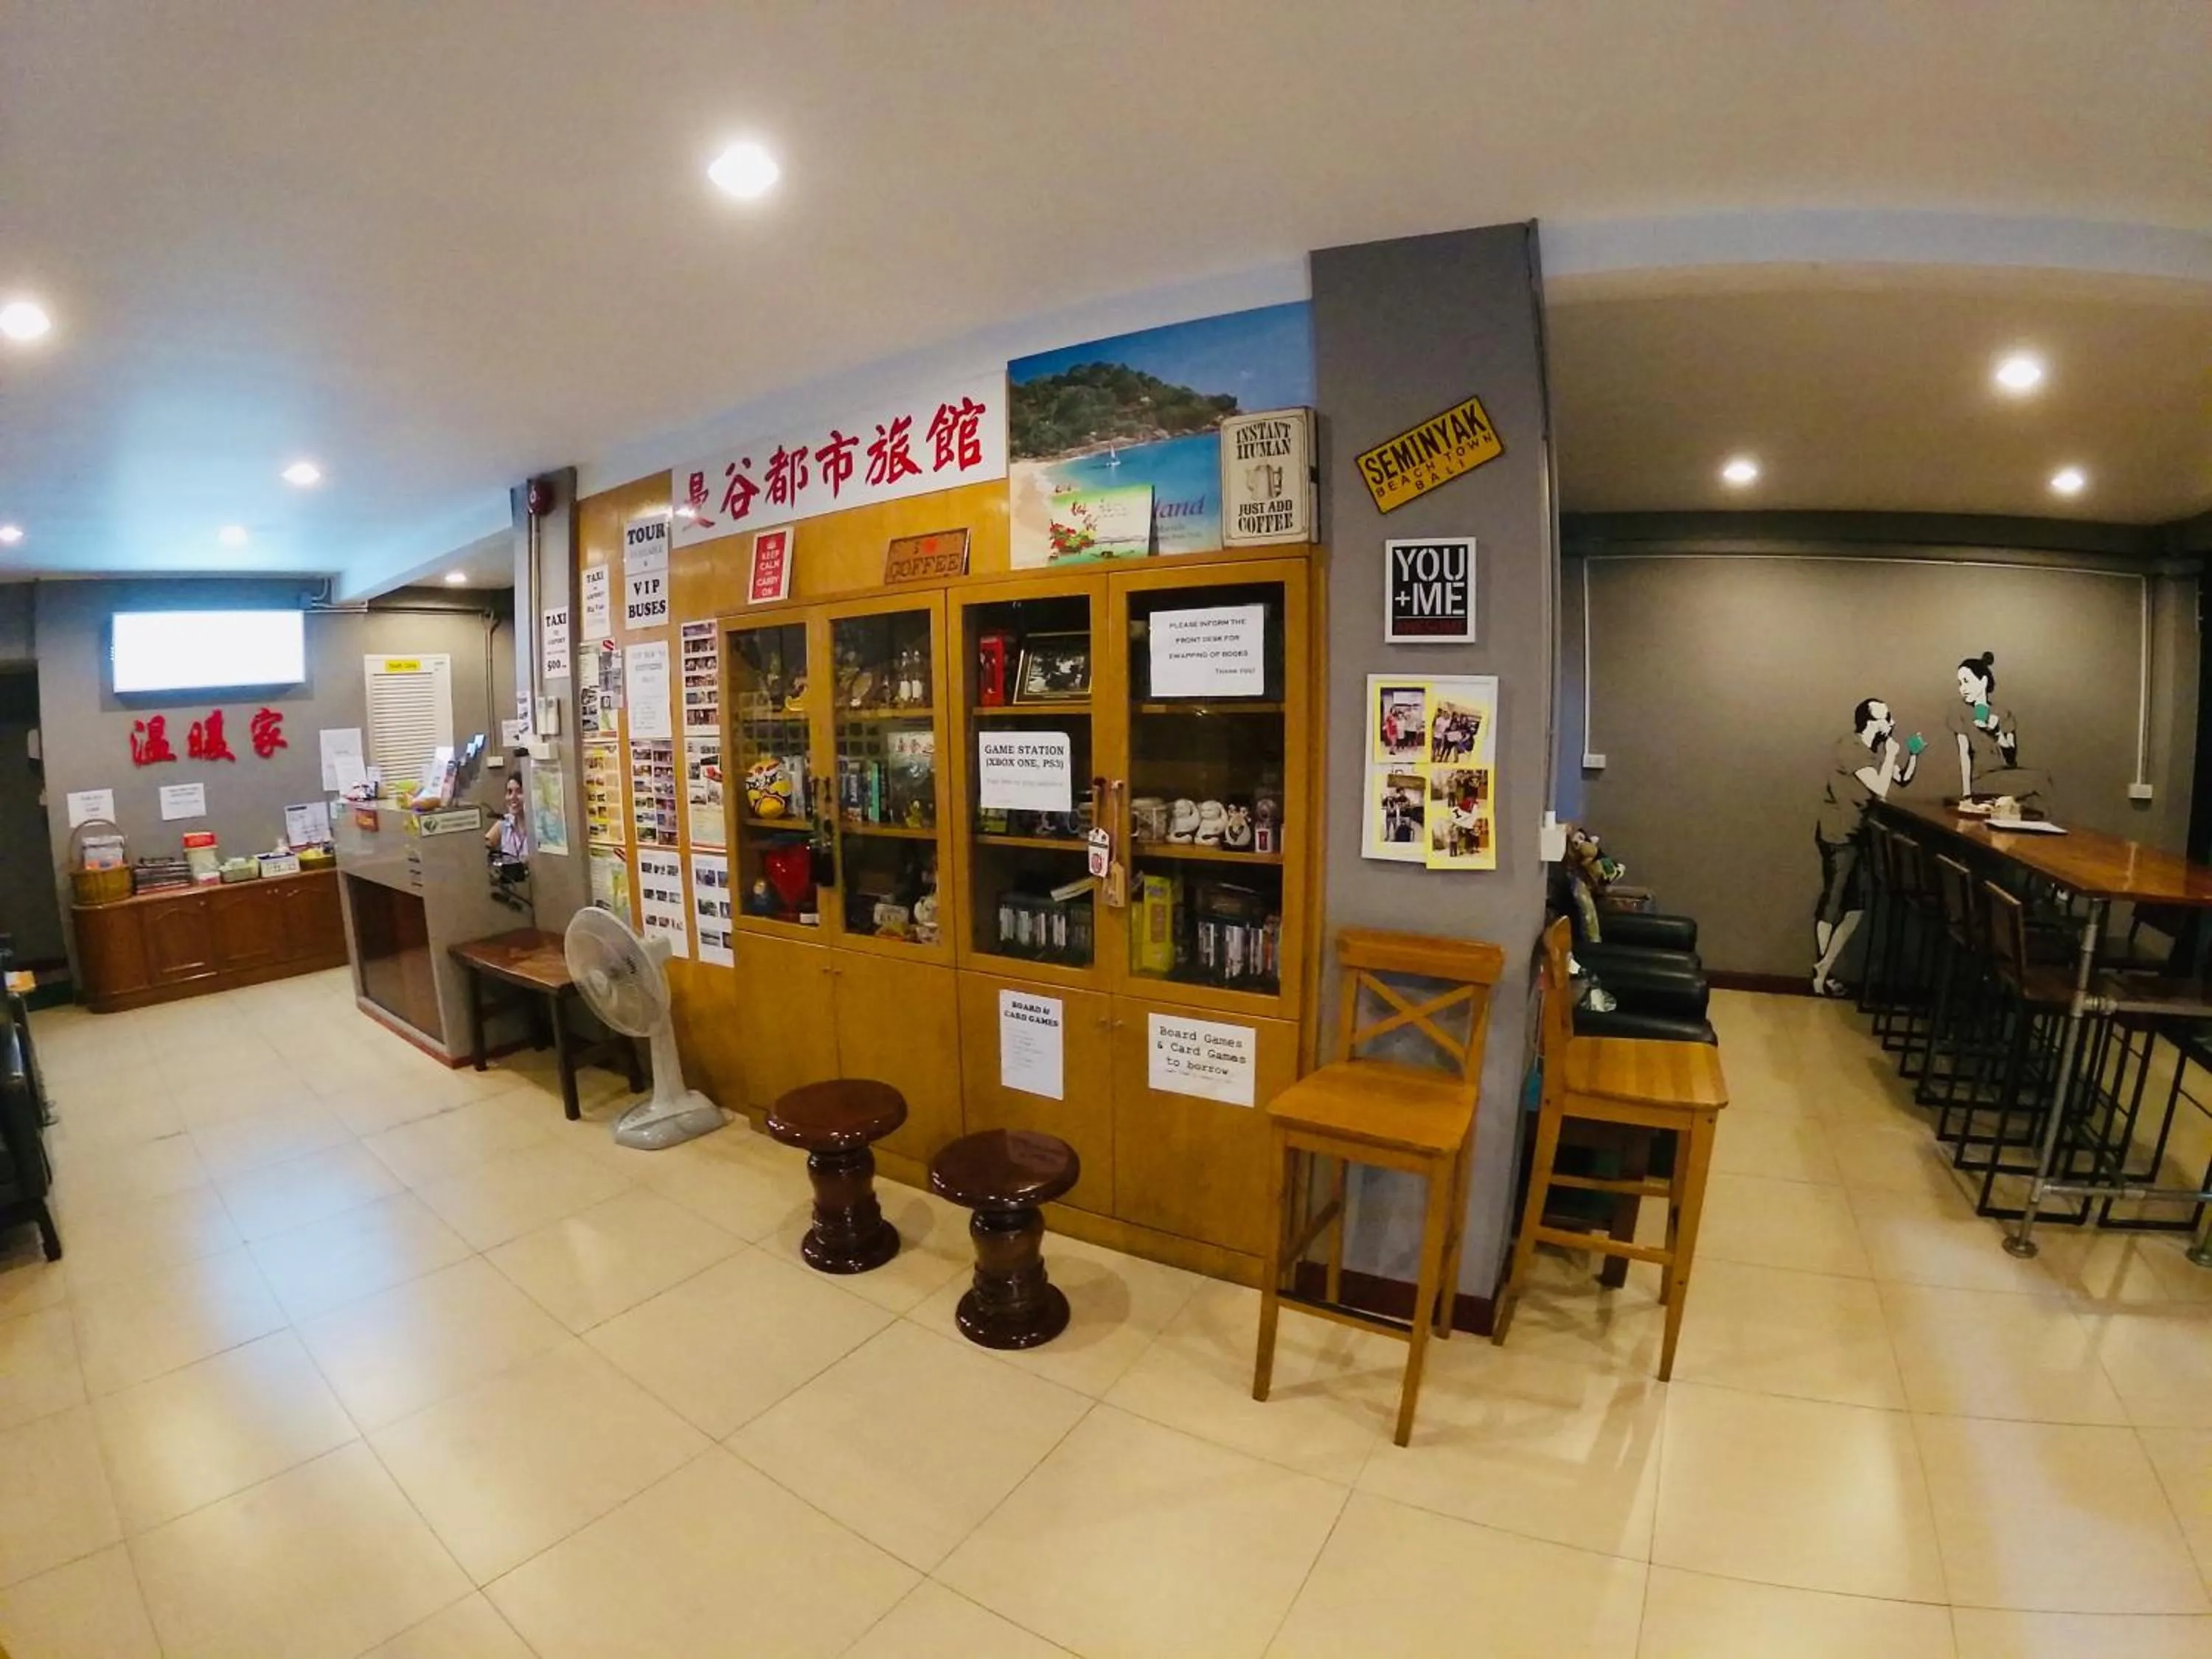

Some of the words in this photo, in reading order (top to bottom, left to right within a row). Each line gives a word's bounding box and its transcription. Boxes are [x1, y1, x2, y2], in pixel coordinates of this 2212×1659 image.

[1237, 421, 1291, 444] INSTANT
[1237, 439, 1290, 460] HUMAN
[1364, 403, 1487, 484] SEMINYAK
[681, 397, 986, 531] 曼谷都市旅館
[1375, 460, 1436, 498] BEACH
[1443, 432, 1492, 462] TOWN
[1415, 459, 1466, 490] BALI
[1239, 502, 1265, 516] JUST
[1267, 499, 1293, 513] ADD
[1238, 512, 1293, 534] COFFEE
[627, 523, 665, 545] TOUR
[888, 553, 961, 579] COFFEE
[1395, 547, 1465, 582] YOU
[586, 571, 604, 583] TAXI
[633, 579, 660, 596] VIP
[628, 599, 666, 619] BUSES
[546, 613, 567, 627] TAXI
[1169, 621, 1197, 629] PLEASE
[984, 744, 1015, 754] GAME
[1018, 745, 1064, 756] STATION
[1012, 1001, 1041, 1013] BOARD
[1004, 1009, 1026, 1021] CARD
[1029, 1015, 1059, 1027] GAMES
[1159, 1026, 1197, 1041] Board
[1204, 1034, 1243, 1048] Games
[1157, 1040, 1163, 1049] &
[1170, 1043, 1200, 1057] Card
[1207, 1048, 1246, 1064] Games
[1166, 1056, 1180, 1067] to
[1186, 1060, 1228, 1075] borrow
